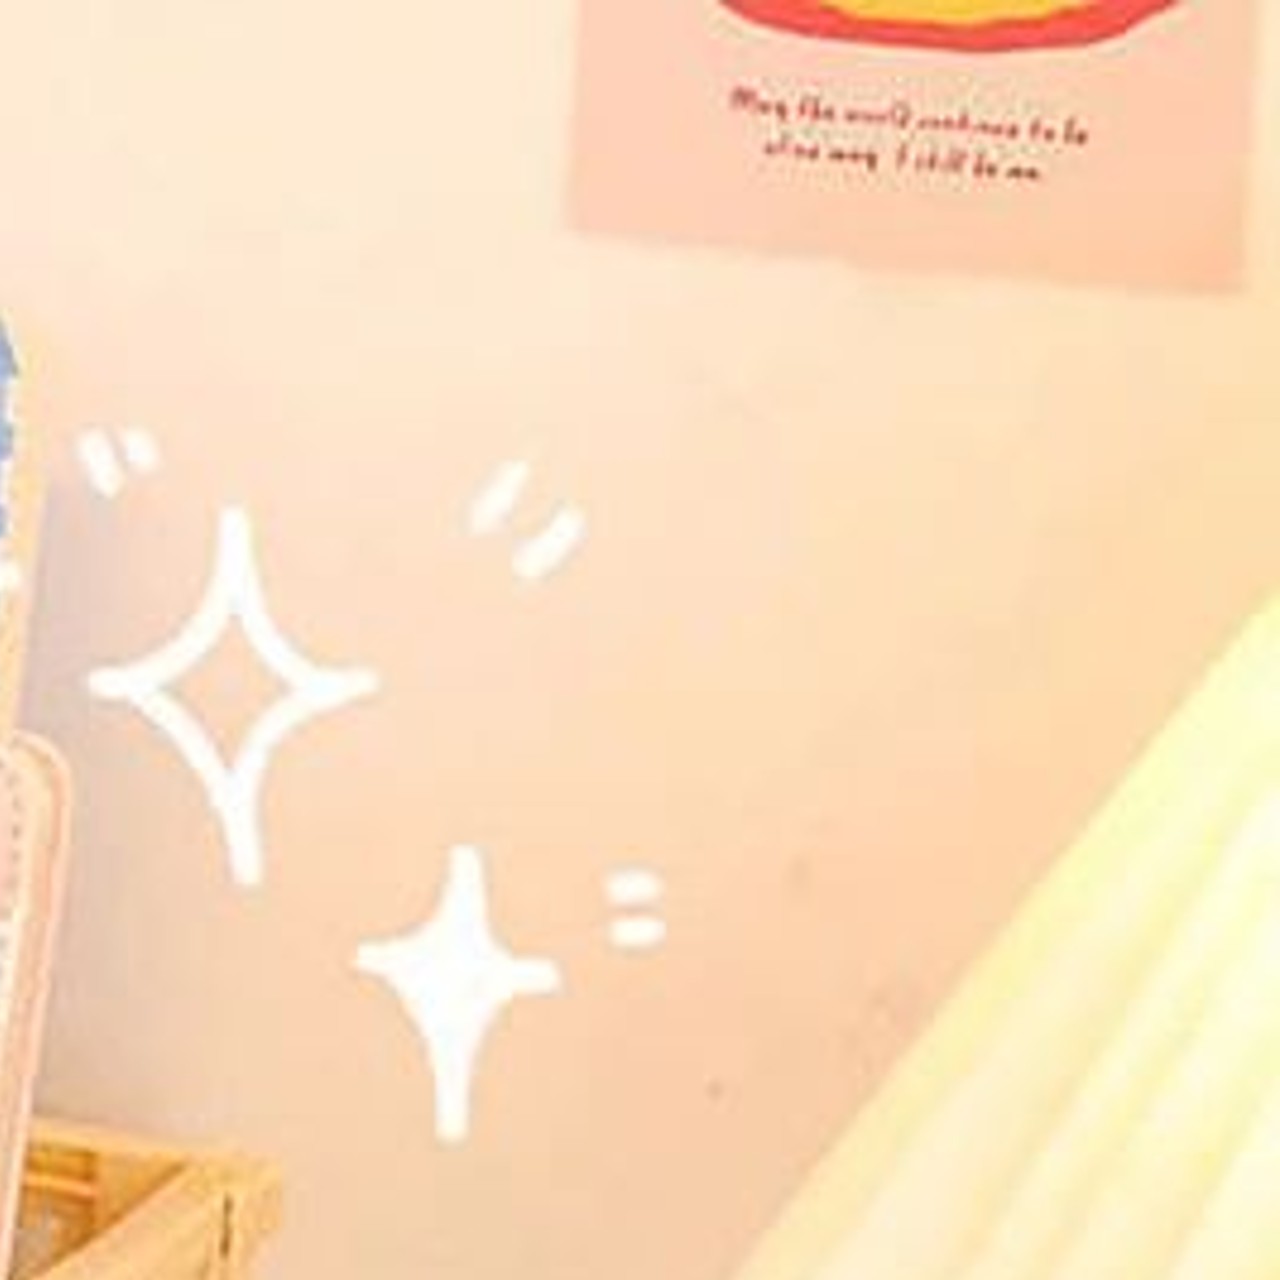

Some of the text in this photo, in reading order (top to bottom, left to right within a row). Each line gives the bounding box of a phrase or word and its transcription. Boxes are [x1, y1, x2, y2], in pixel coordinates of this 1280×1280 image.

[798, 94, 836, 121] the
[1029, 117, 1055, 141] to
[1063, 116, 1088, 146] be
